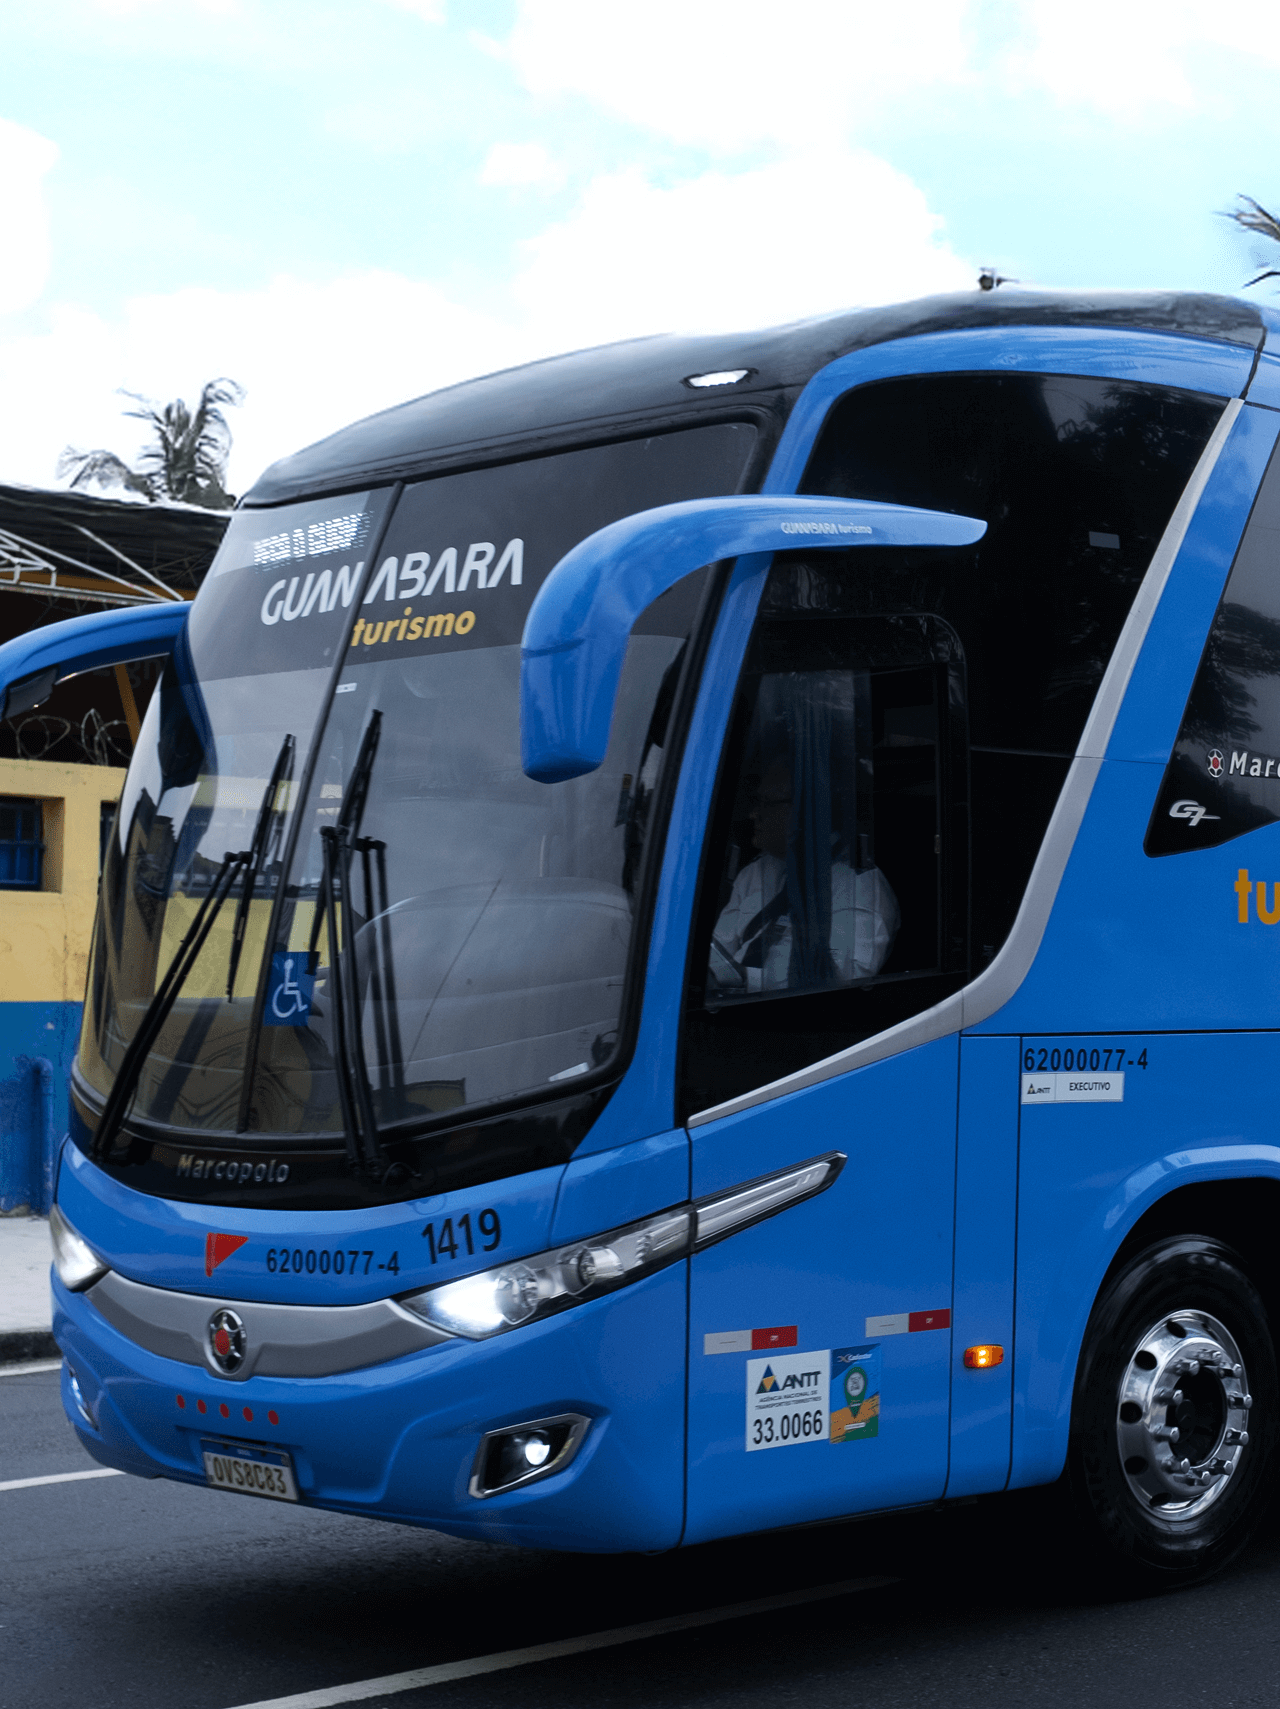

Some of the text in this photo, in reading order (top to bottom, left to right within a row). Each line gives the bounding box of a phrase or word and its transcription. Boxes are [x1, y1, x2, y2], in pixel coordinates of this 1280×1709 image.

[260, 538, 524, 625] GUANABARA
[351, 607, 476, 647] turismo
[1024, 1047, 1148, 1071] 62000077-4
[1069, 1082, 1111, 1091] EXECUTIVO
[176, 1154, 290, 1184] Marcopolo
[422, 1208, 501, 1265] 1419
[266, 1248, 400, 1277] 62000077-4
[780, 1371, 821, 1390] ANTT
[753, 1409, 823, 1445] 33.0066
